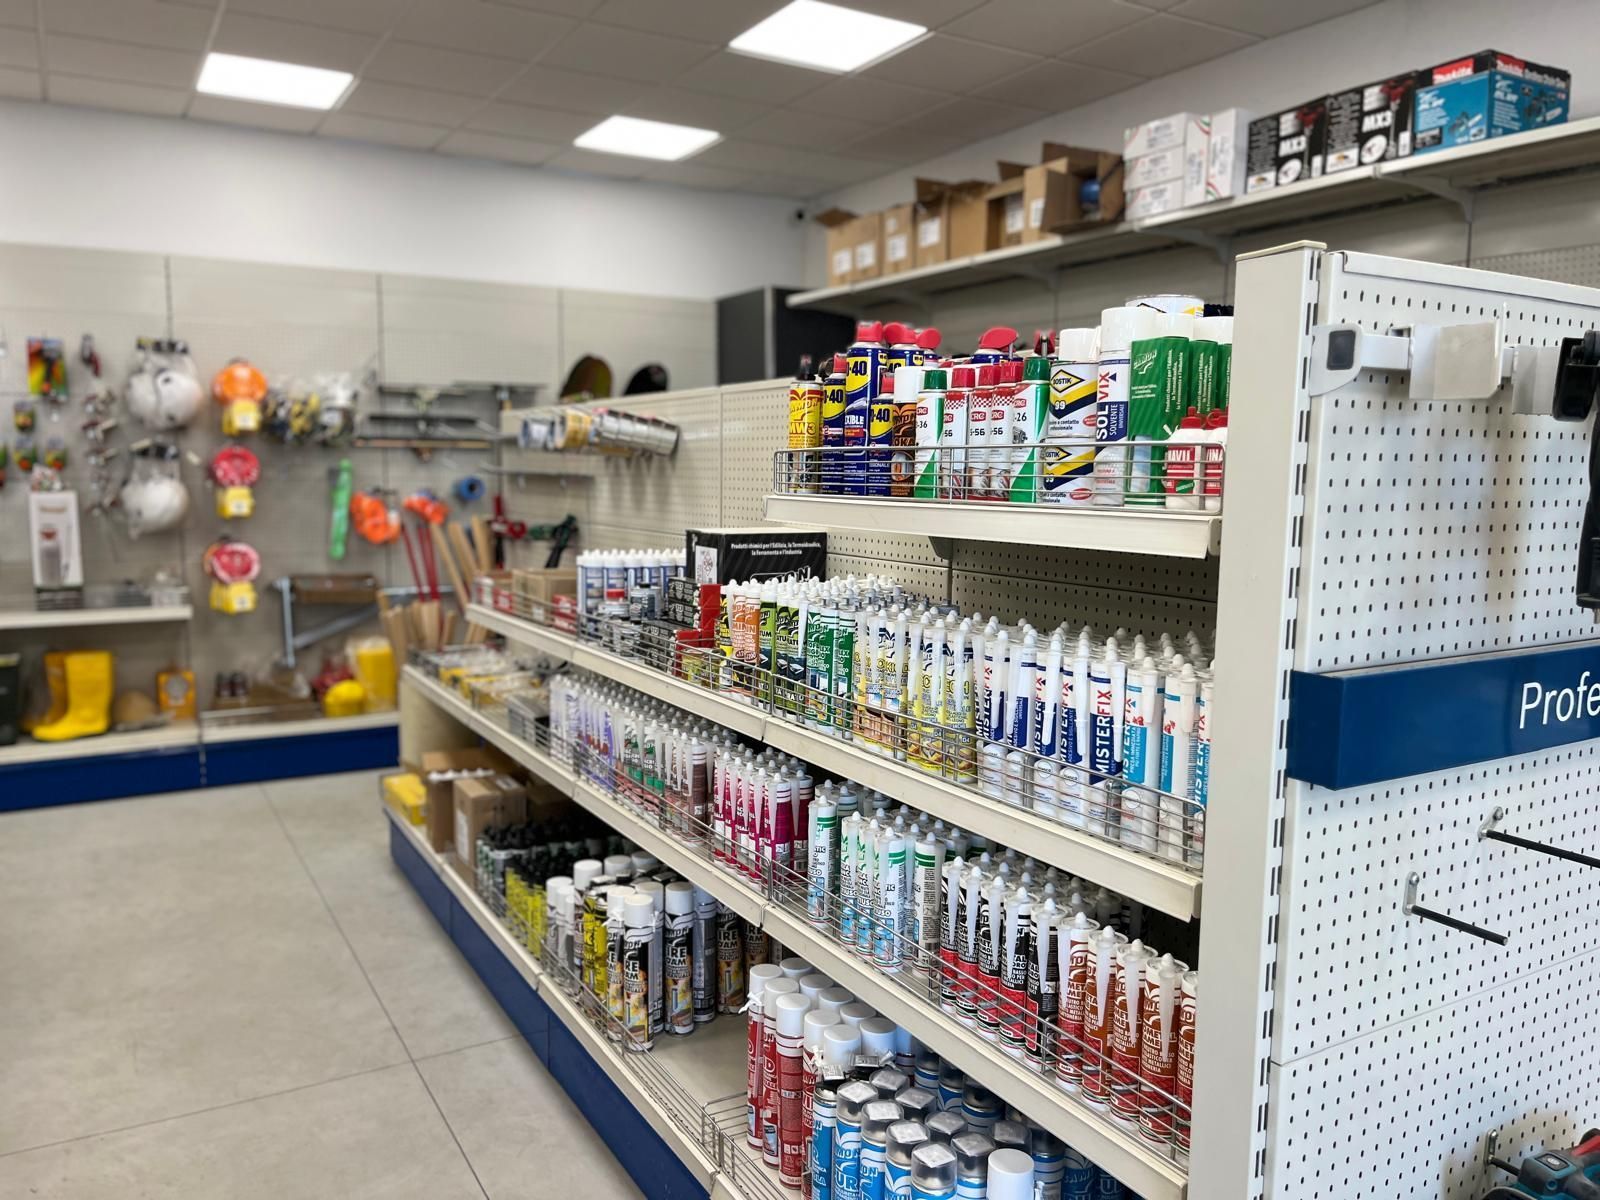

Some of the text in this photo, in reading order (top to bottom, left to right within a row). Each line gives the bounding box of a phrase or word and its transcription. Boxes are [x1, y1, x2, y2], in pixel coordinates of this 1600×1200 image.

[1362, 110, 1393, 132] MX3
[1279, 135, 1306, 157] MX3
[1054, 400, 1066, 410] 99
[917, 420, 928, 429] -36
[1014, 412, 1027, 422] -26
[1110, 404, 1118, 436] SOLVENTE
[1095, 690, 1112, 774] MISTERFIX
[835, 1170, 858, 1192] UR
